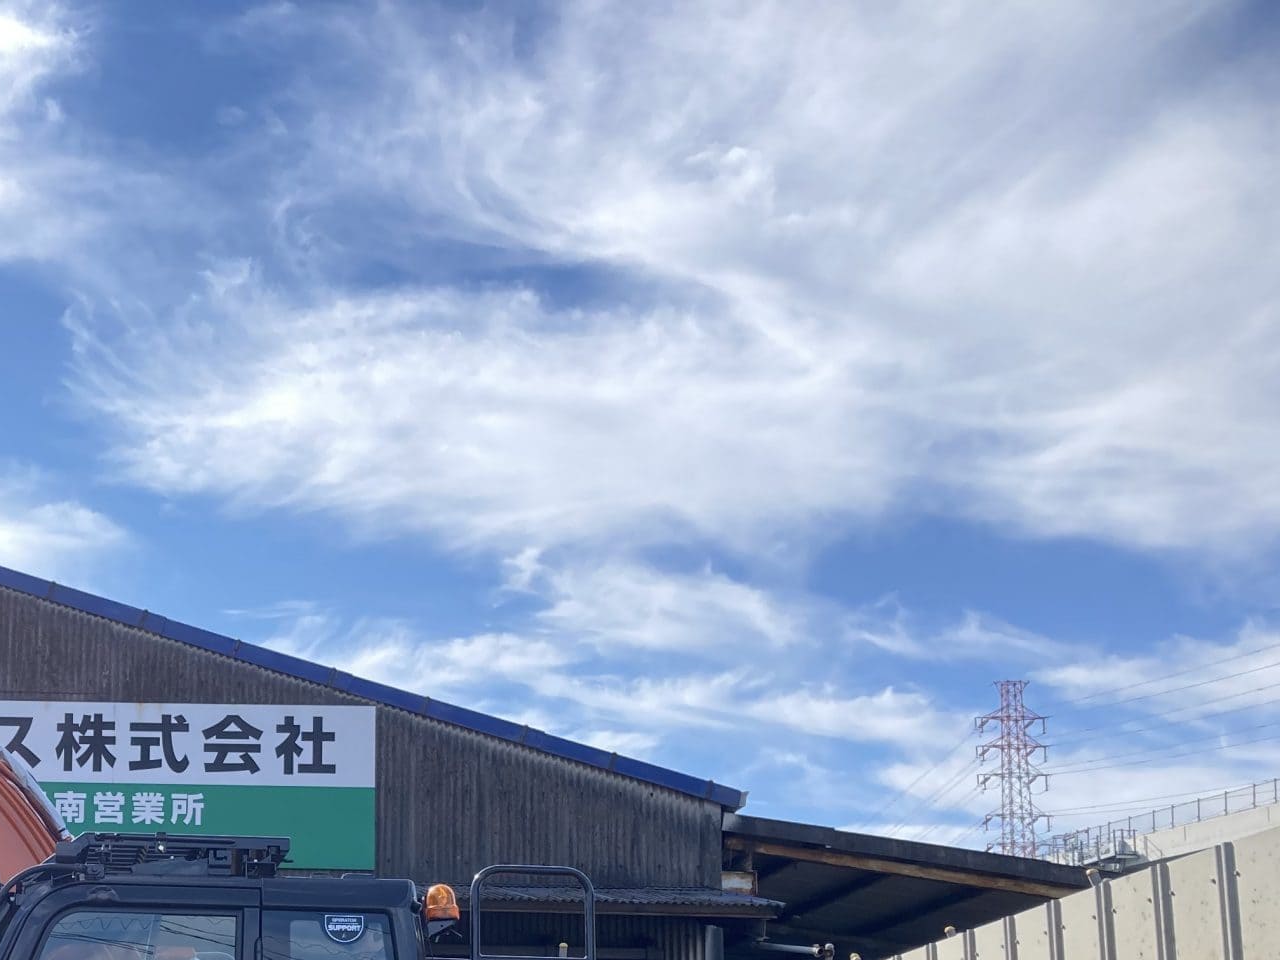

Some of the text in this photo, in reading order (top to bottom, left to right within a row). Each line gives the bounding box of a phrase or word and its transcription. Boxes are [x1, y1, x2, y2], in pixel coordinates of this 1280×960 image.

[42, 790, 205, 827] 南営業所
[327, 924, 361, 932] SUPPORT
